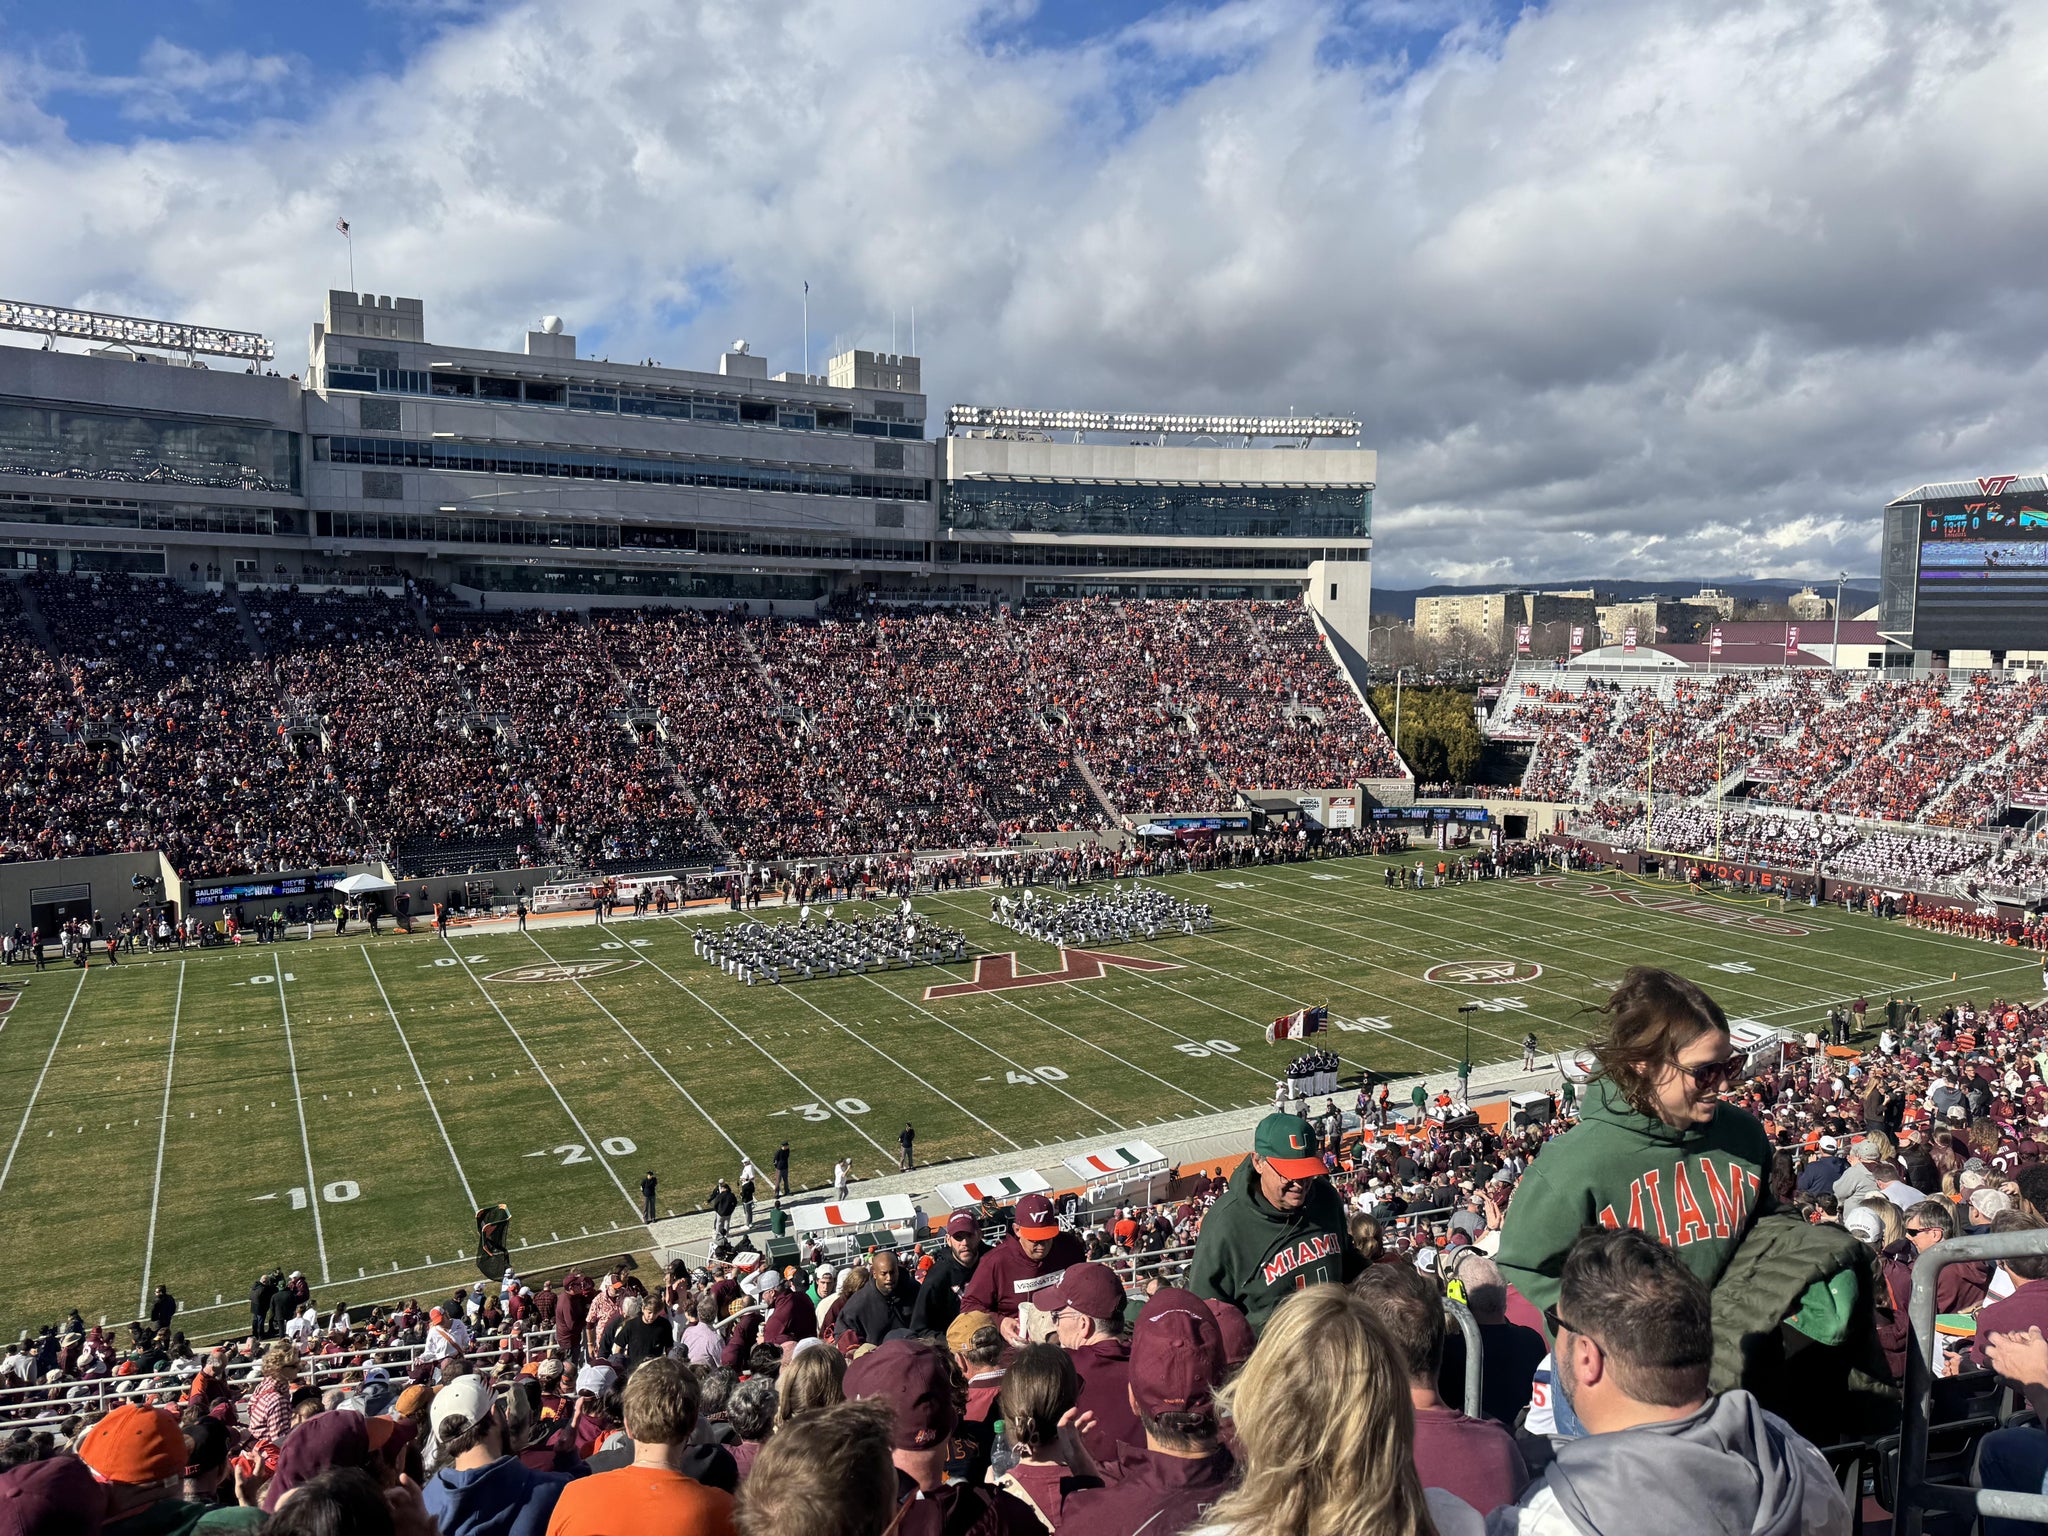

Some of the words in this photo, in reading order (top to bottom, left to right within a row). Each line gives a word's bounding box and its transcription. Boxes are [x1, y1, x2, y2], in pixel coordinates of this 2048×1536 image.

[1977, 474, 2019, 496] VT
[1964, 503, 1986, 514] VT
[1931, 519, 1937, 532] 0
[1943, 520, 1967, 533] 13:17
[1972, 516, 1979, 530] 0
[1519, 635, 1530, 645] 84
[1573, 636, 1581, 646] 10
[1624, 635, 1636, 646] 25
[1789, 636, 1796, 647] 7
[1332, 797, 1352, 805] ACC
[1411, 809, 1430, 819] NAVY
[1465, 810, 1485, 820] NAVY
[281, 879, 306, 887] THEY'RE
[195, 887, 223, 897] SAILORS
[281, 886, 306, 894] FORGED
[195, 895, 218, 905] AREN'T
[219, 894, 238, 902] BORN
[1334, 1015, 1393, 1033] 40
[1173, 1039, 1242, 1059] 50
[1006, 1066, 1070, 1086] 40
[790, 1097, 873, 1123] 30
[1289, 1133, 1308, 1151] U
[552, 1136, 638, 1166] 20
[1086, 1147, 1140, 1172] U
[963, 1176, 1022, 1200] U
[284, 1180, 361, 1210] 10
[1204, 1194, 1217, 1206] 25
[824, 1200, 885, 1226] U
[1029, 1210, 1049, 1223] VT
[1263, 1233, 1341, 1286] MIAMI
[1534, 1382, 1546, 1407] 5
